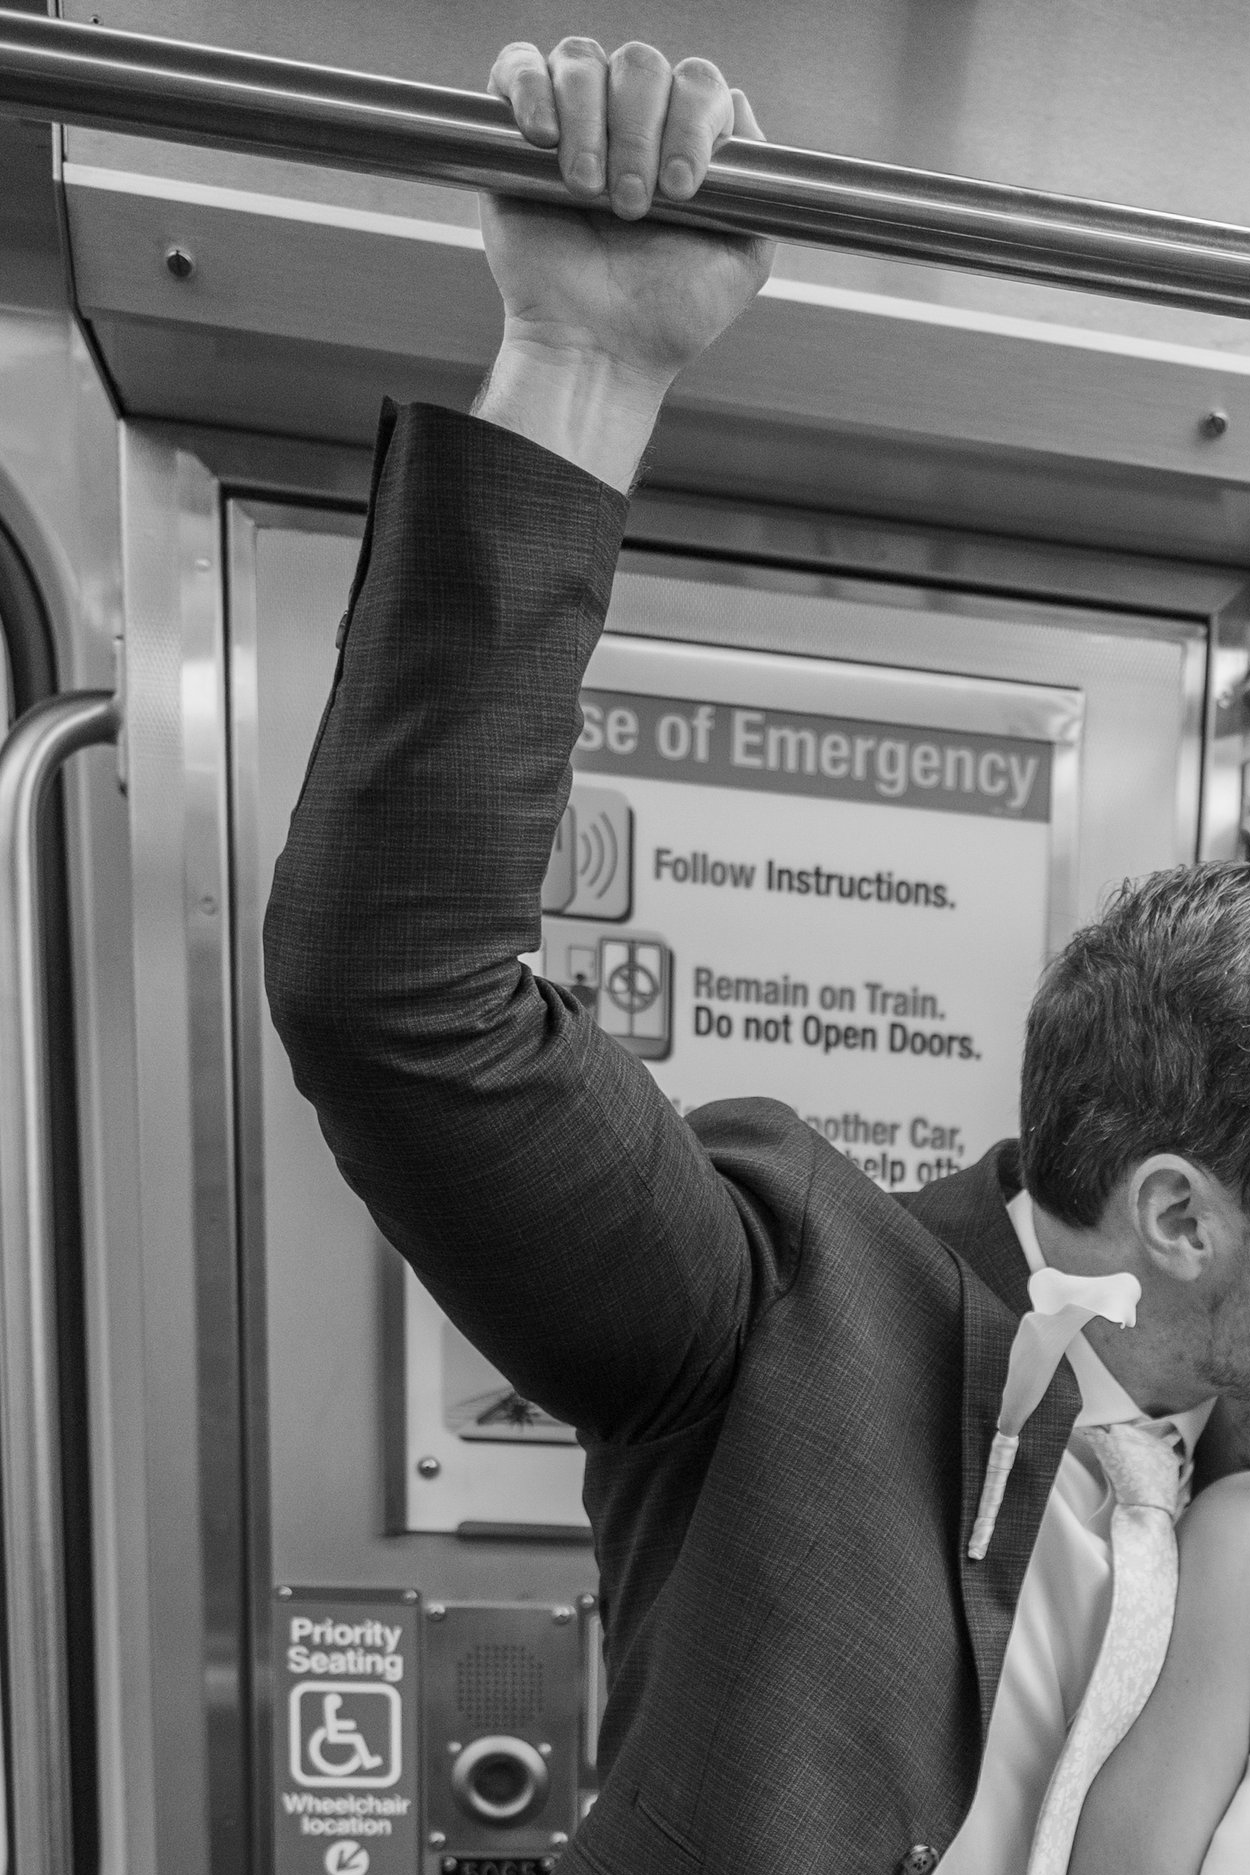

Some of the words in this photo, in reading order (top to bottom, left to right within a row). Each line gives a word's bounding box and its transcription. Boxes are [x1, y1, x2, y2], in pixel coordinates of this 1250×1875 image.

[658, 705, 715, 763] of
[731, 709, 1039, 810] Emergency
[654, 848, 755, 889] Follow
[767, 859, 956, 910] Instructions.
[694, 966, 809, 1008] Remain
[818, 984, 857, 1012] on
[864, 981, 946, 1020] Train.
[694, 1005, 733, 1039] Do
[744, 1014, 793, 1044] not
[803, 1015, 878, 1055] Open
[889, 1022, 982, 1061] Doors.
[910, 1116, 965, 1155] Car,
[290, 1616, 402, 1654] Priority
[287, 1645, 404, 1682] Seating
[283, 1792, 411, 1816] Wheelchair
[302, 1814, 392, 1836] location
